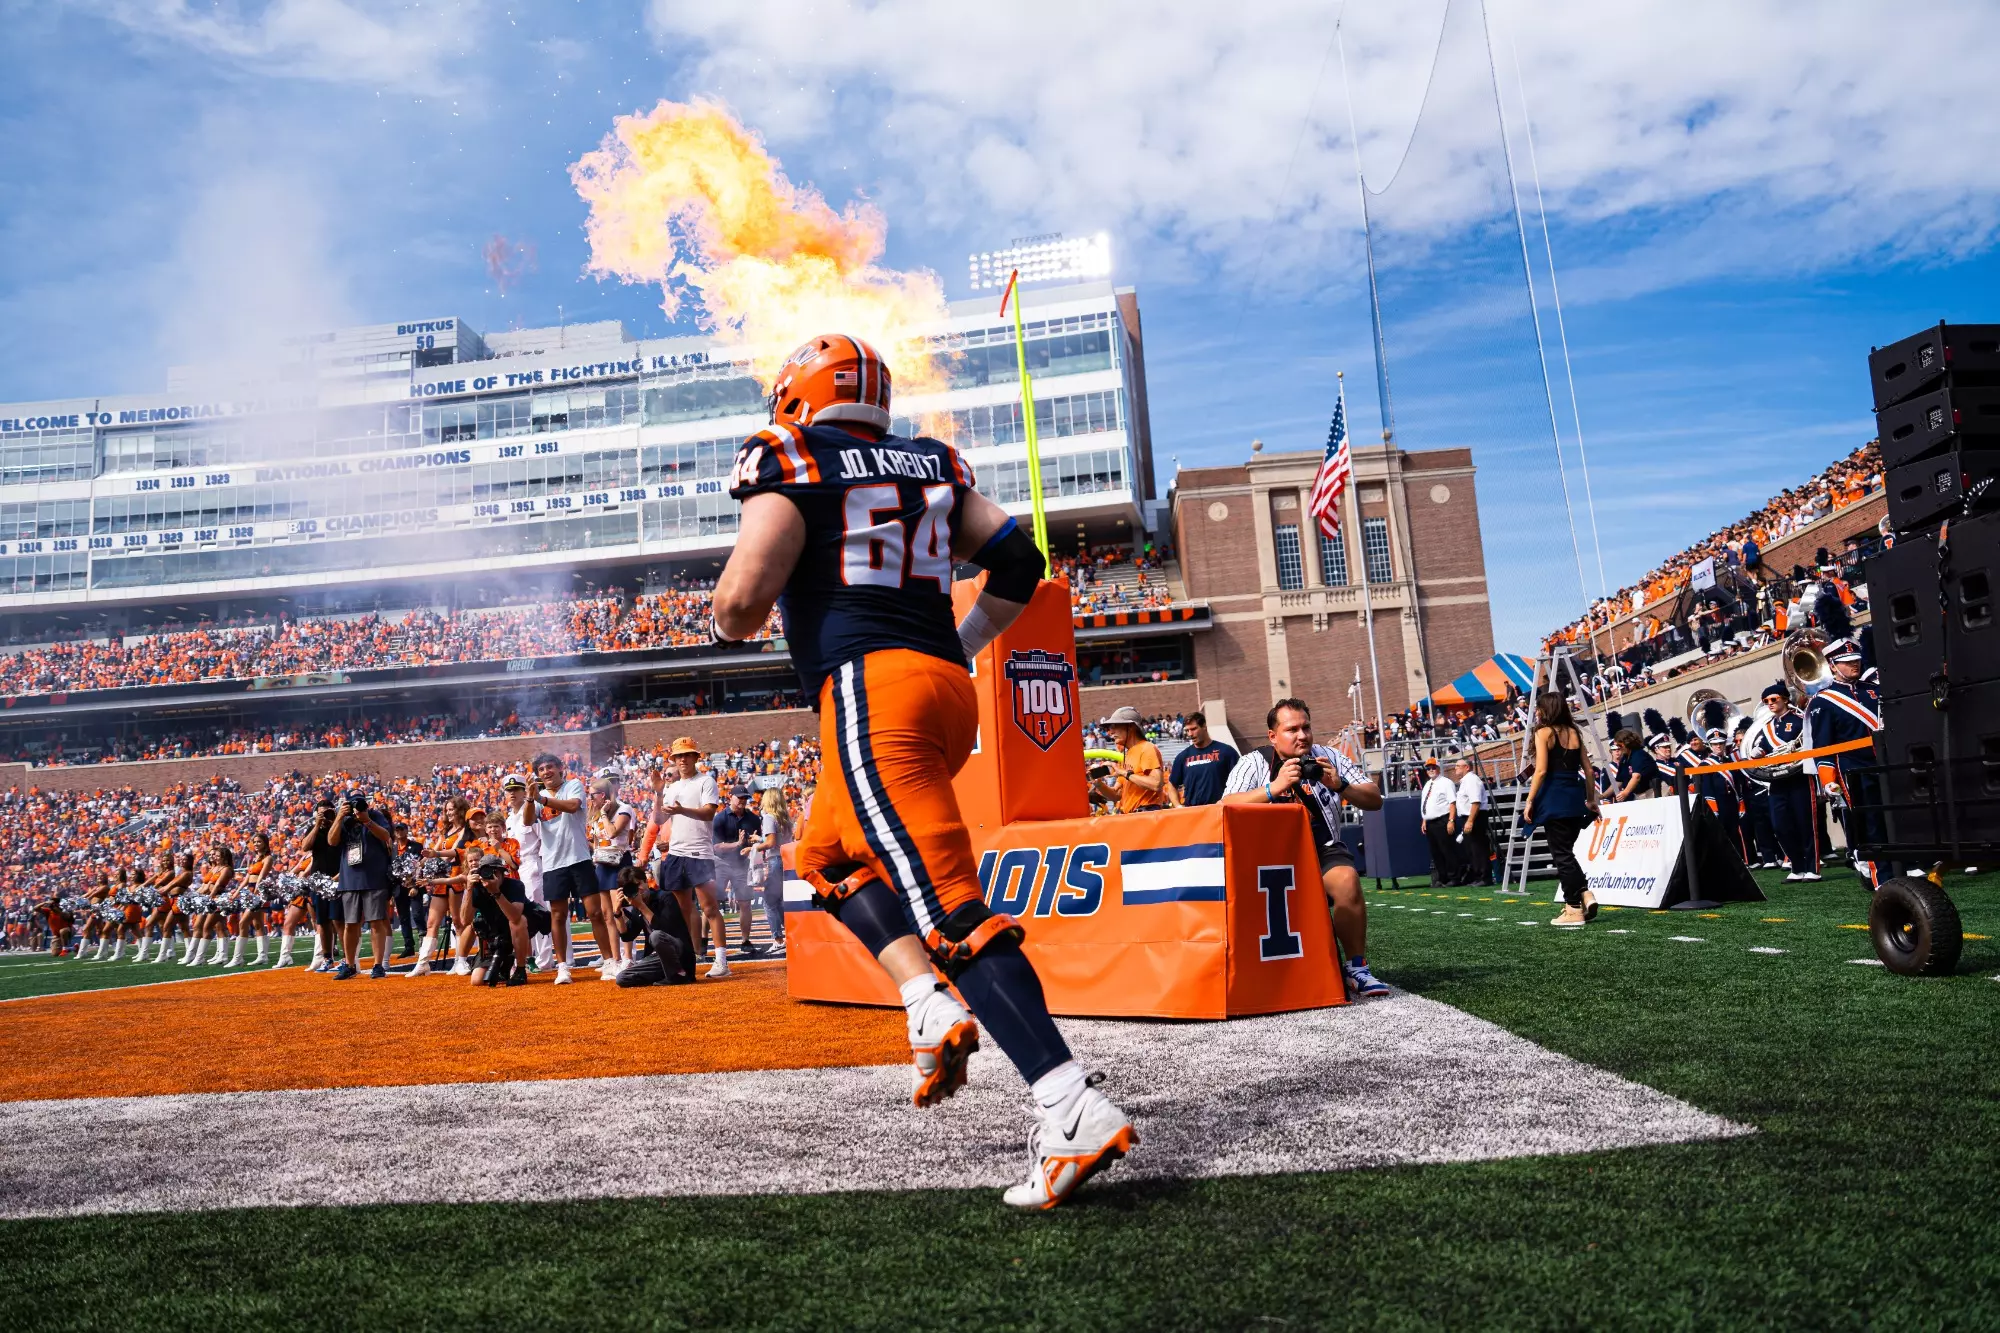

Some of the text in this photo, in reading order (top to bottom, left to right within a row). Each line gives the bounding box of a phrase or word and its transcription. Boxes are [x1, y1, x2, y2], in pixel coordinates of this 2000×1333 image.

[397, 320, 454, 336] BUTKUS
[416, 335, 434, 350] 50
[410, 380, 466, 397] HOME
[473, 376, 498, 390] OF
[506, 370, 544, 387] THE
[550, 358, 644, 381] FIGHTING
[0, 414, 79, 432] ELCOME
[86, 412, 112, 425] TO
[120, 404, 224, 424] MEMORIAL
[136, 441, 559, 491] 1914 1919 1923 NATIONAL CHAMPIONS 1927 1951
[840, 448, 946, 482] JO. KREUTZ
[53, 540, 78, 551] 1915
[89, 537, 112, 549] 1918
[124, 534, 148, 546] 1919
[158, 532, 183, 544] 1923
[194, 529, 219, 541] 1927
[325, 509, 438, 531] CHAMPIONS
[511, 501, 535, 513] 1951
[546, 497, 572, 510] 1953
[583, 493, 609, 506] 1963
[620, 488, 646, 502] 1983
[658, 485, 684, 498] 1990
[696, 481, 722, 494] 2001
[840, 483, 955, 595] 64
[506, 659, 536, 672] KREUTZ
[1018, 679, 1065, 715] 100
[1038, 721, 1049, 737] I
[1785, 722, 1793, 732] I
[1588, 817, 1611, 861] U
[1602, 827, 1618, 856] of
[1620, 839, 1661, 849] CREDIT UNION
[1625, 824, 1665, 837] COMMUNITY
[1257, 865, 1304, 962] I
